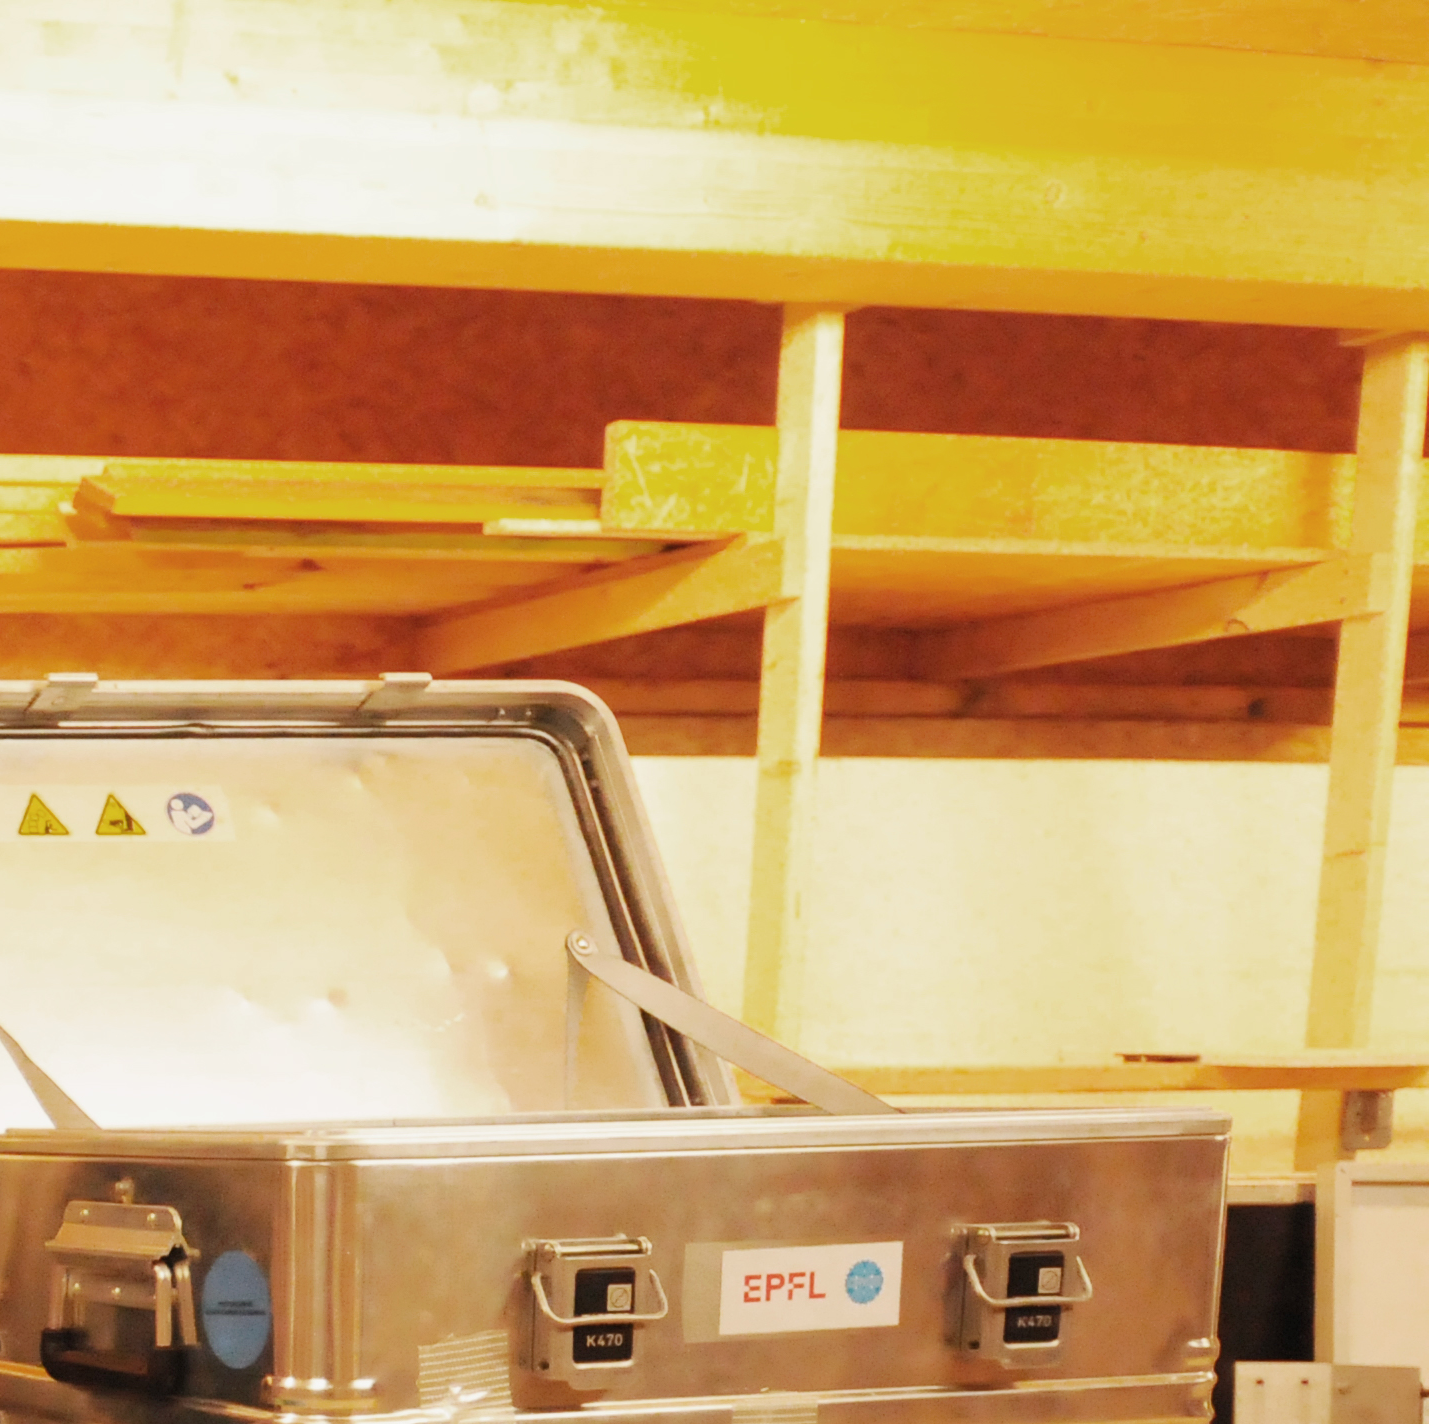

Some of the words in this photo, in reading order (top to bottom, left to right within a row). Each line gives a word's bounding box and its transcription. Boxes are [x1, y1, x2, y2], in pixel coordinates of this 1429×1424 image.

[743, 1271, 826, 1303] EPFL
[1017, 1315, 1052, 1328] K470
[586, 1332, 623, 1347] K470
